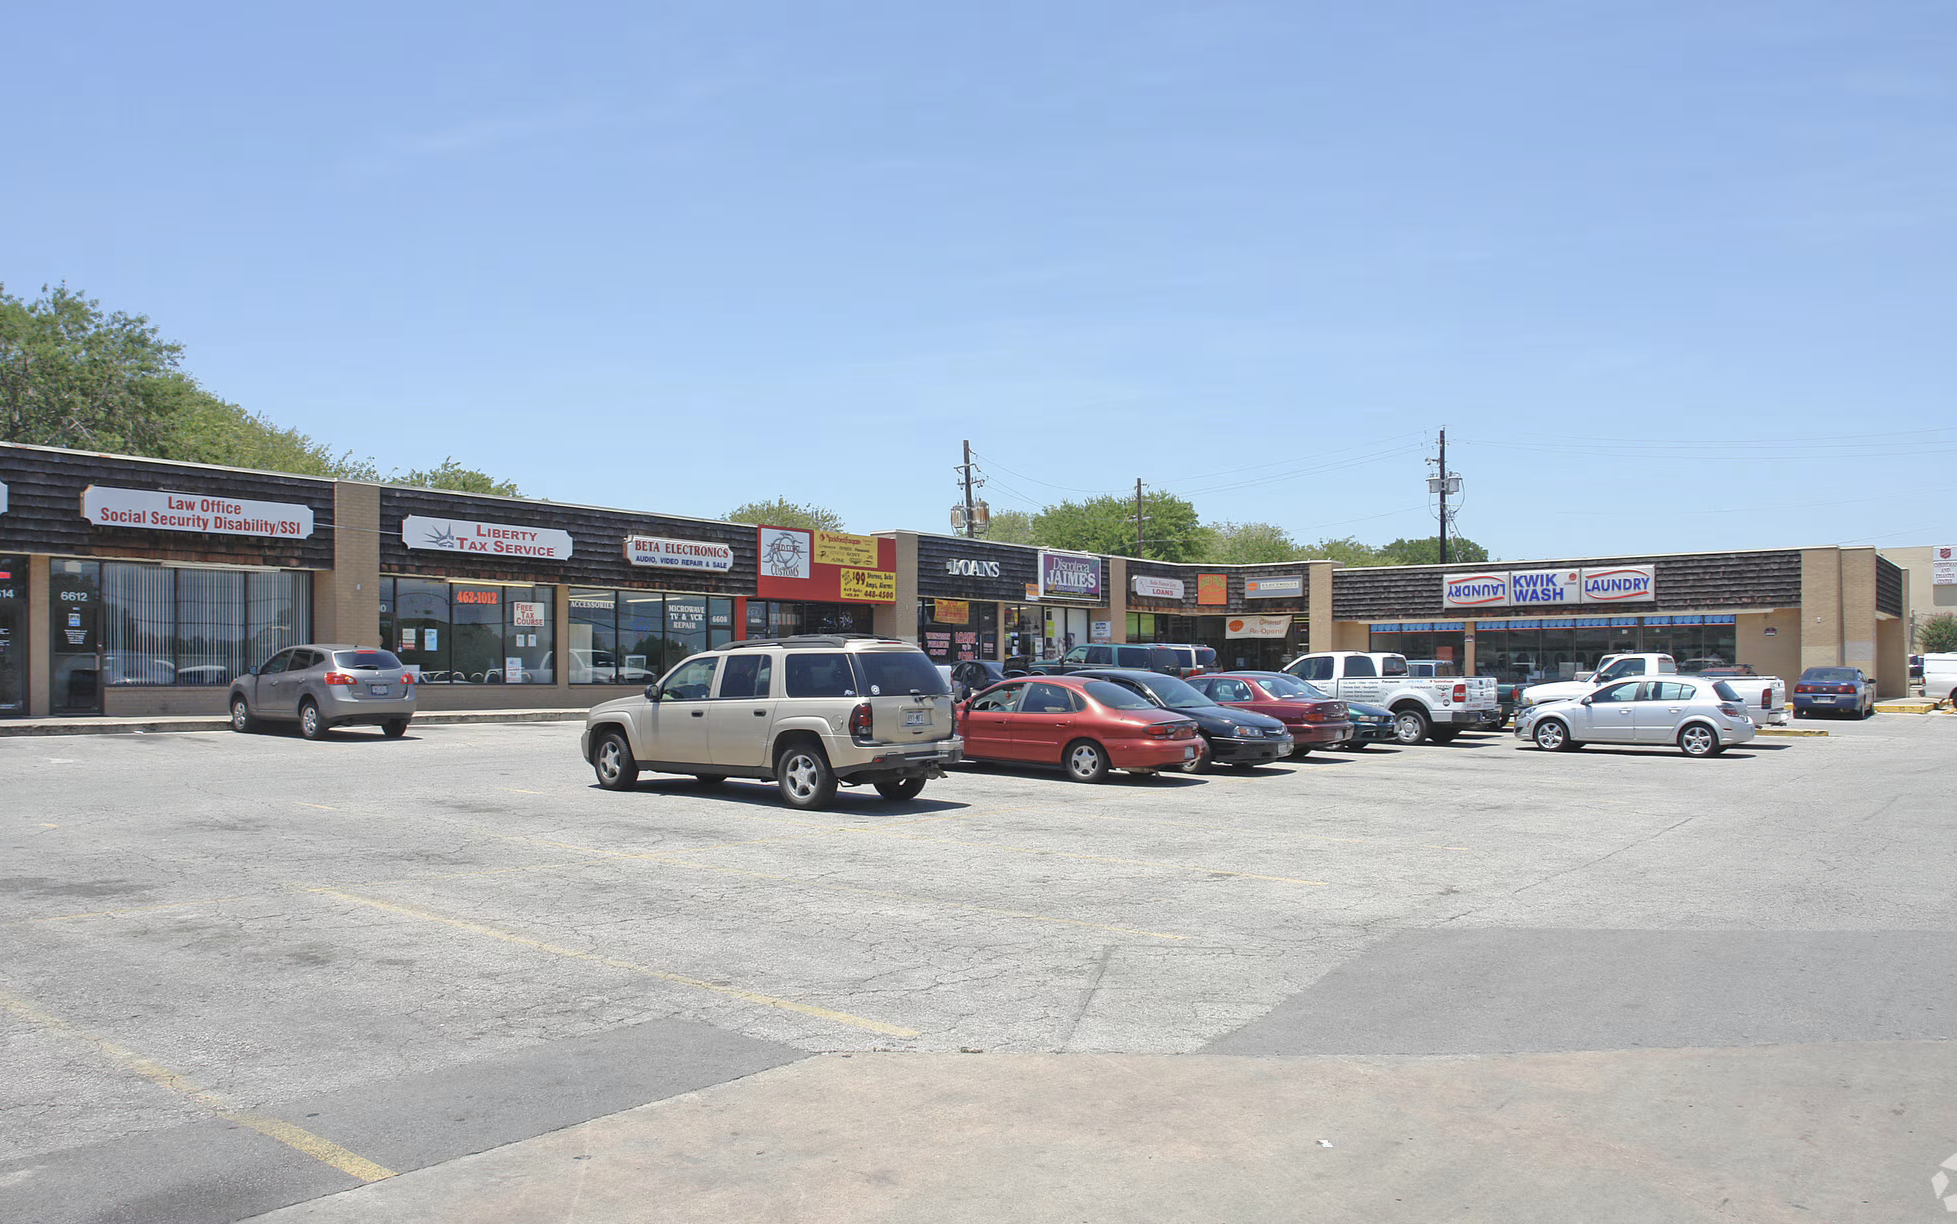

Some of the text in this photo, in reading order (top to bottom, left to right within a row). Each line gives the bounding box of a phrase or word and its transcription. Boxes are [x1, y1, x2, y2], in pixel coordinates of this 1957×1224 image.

[168, 496, 242, 515] Law Office
[101, 507, 301, 535] Social Security Disability/SSI
[476, 524, 538, 542] LIBERTY
[456, 536, 555, 557] TAX SERVICE
[635, 540, 729, 559] BETA ELECTRONICS
[635, 555, 658, 564] AUDIO,
[660, 558, 679, 566] VIDEO
[681, 559, 703, 567] REPAIR
[947, 558, 1000, 577] LOANS
[1053, 557, 1090, 573] Discoteca
[771, 564, 800, 577] CUSTOMS
[1047, 570, 1096, 588] JAIMES
[1512, 573, 1557, 589] KWIK
[1584, 577, 1650, 592] LAUNDRY
[0, 589, 14, 599] 14
[60, 591, 88, 602] 6612
[456, 590, 498, 605] 462-1012
[1447, 583, 1506, 598] LAUNDRY
[1514, 587, 1564, 602] WASH
[516, 603, 533, 612] FREE
[570, 601, 615, 610] ACCESSORIES
[668, 605, 705, 614] MICROWAVE
[516, 618, 544, 626] COURSE
[520, 611, 535, 619] TAX
[669, 613, 679, 621] TV
[1259, 617, 1281, 625] Grand
[673, 621, 697, 630] REPAIR
